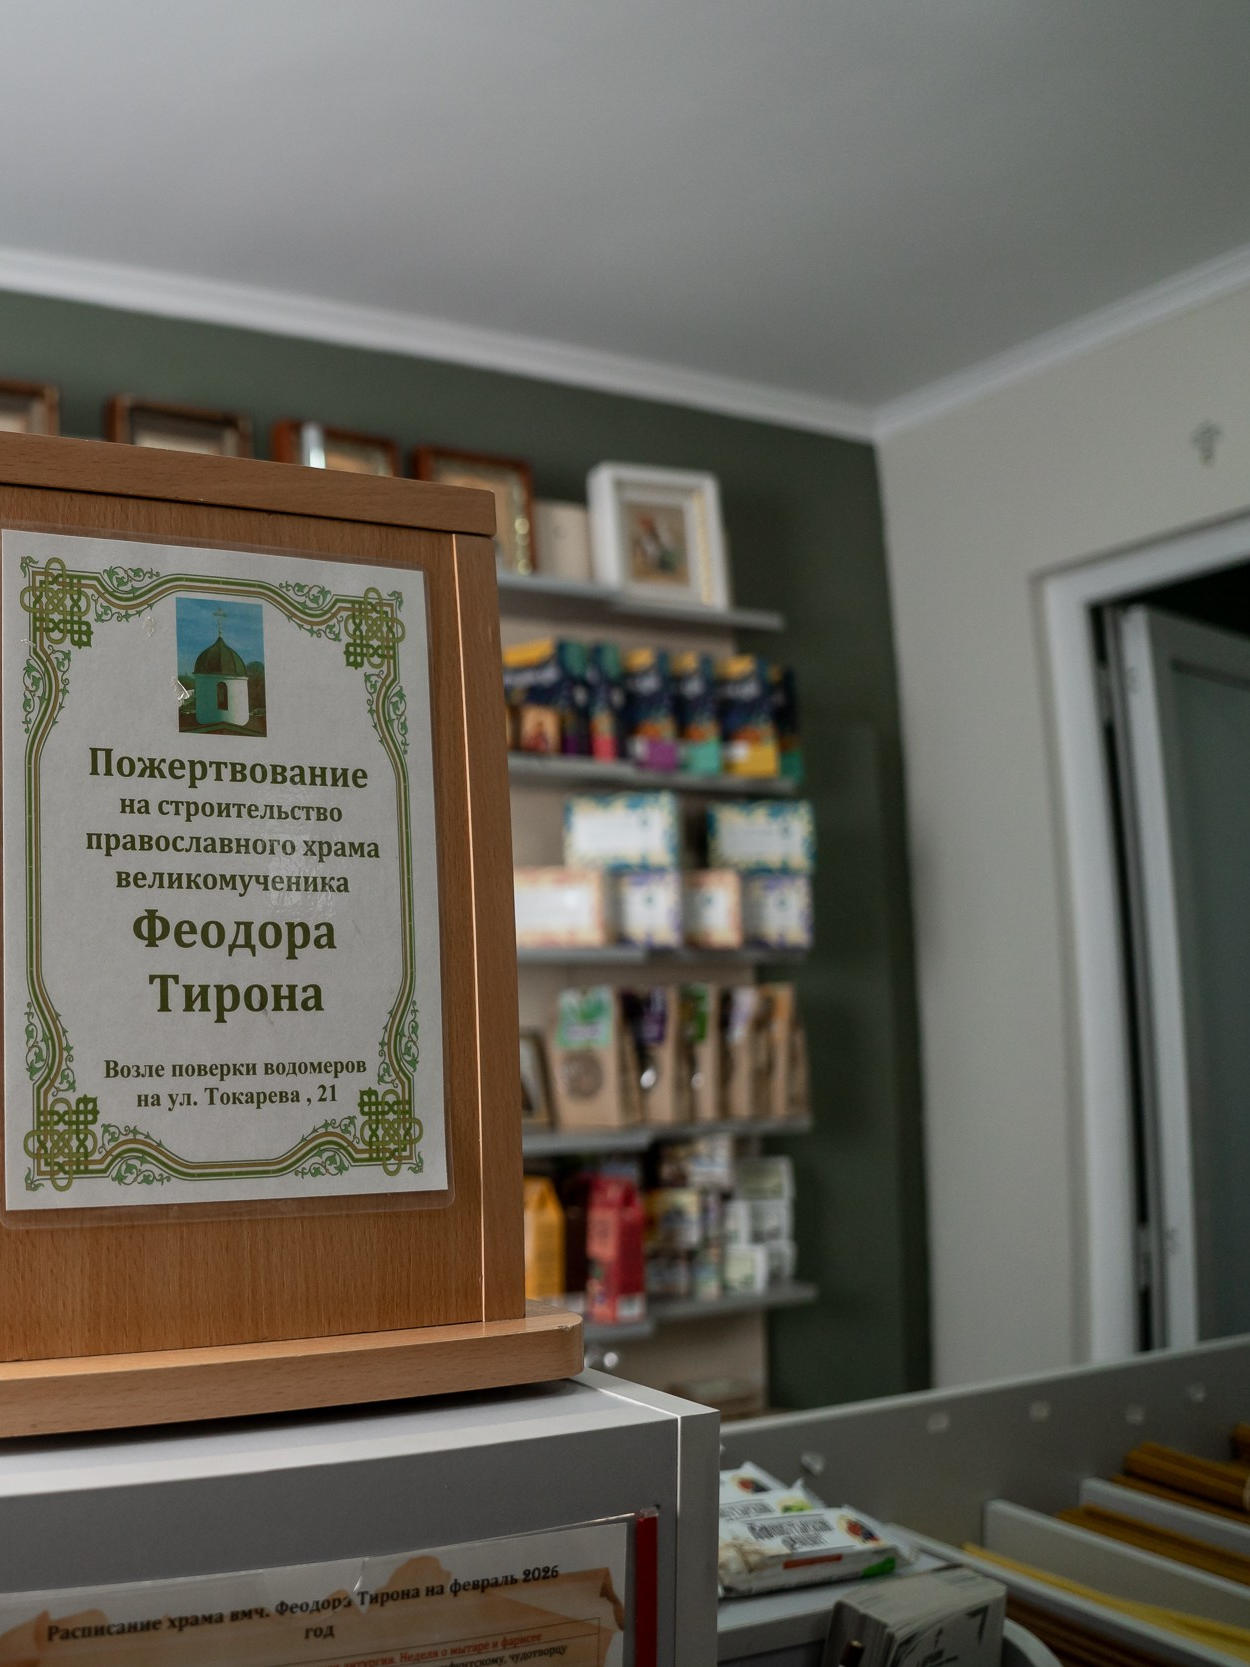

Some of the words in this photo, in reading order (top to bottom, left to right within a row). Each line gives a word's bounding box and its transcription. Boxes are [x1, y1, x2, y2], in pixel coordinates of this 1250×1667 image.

[89, 747, 368, 788] Пожертвование
[119, 797, 150, 815] на
[157, 799, 343, 822] строительство
[85, 832, 296, 857] православного
[302, 838, 380, 862] храма
[115, 870, 350, 897] великомученика
[132, 908, 337, 960] Феодора
[148, 974, 325, 1023] Тирона
[103, 1059, 165, 1078] Возле
[171, 1062, 258, 1081] поверки
[263, 1059, 367, 1079] водомеров
[137, 1092, 161, 1107] на
[167, 1090, 198, 1111] ул.
[204, 1087, 300, 1109] Токарева
[317, 1084, 338, 1102] 21
[47, 1618, 162, 1641] Расписание
[167, 1611, 224, 1632] храма
[230, 1606, 270, 1622] вмч.
[275, 1595, 352, 1615] Феодора
[357, 1587, 420, 1607] Тирона
[425, 1586, 444, 1598] на
[450, 1573, 518, 1596] февраль
[522, 1565, 559, 1583] 2026
[304, 1624, 335, 1640] год
[400, 1652, 439, 1663] Неделя
[450, 1642, 490, 1655] мытаре
[492, 1640, 498, 1648] и
[501, 1634, 543, 1648] фарисее
[508, 1644, 568, 1662] чудотворцу
